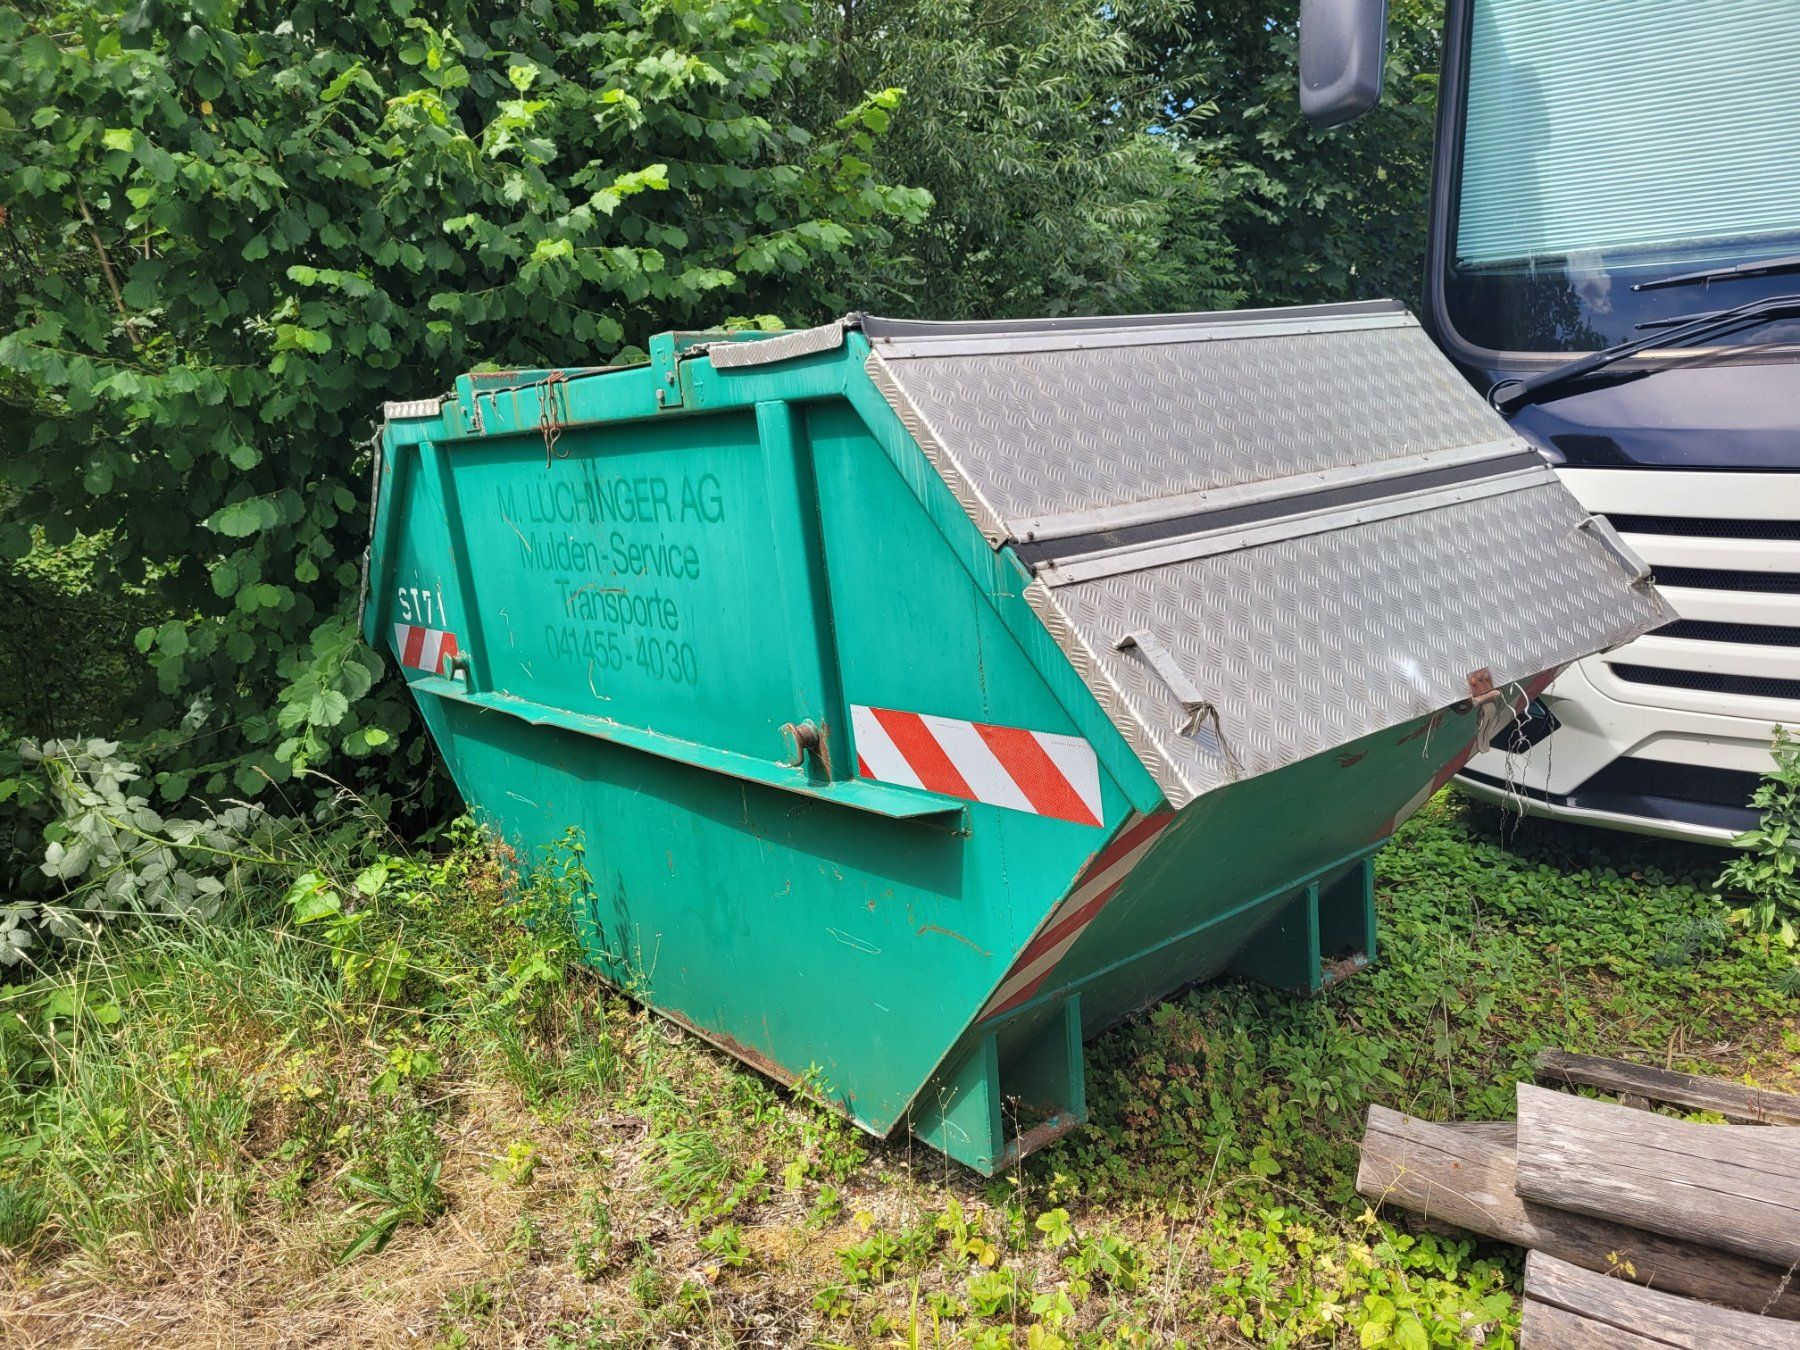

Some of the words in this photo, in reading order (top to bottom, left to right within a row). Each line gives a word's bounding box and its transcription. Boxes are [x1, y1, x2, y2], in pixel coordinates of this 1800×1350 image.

[496, 484, 522, 524] M.
[525, 472, 673, 524] LÜCHINGER
[681, 472, 726, 524] AG
[518, 530, 700, 580] Mulden-Service
[554, 578, 680, 635] Transporte
